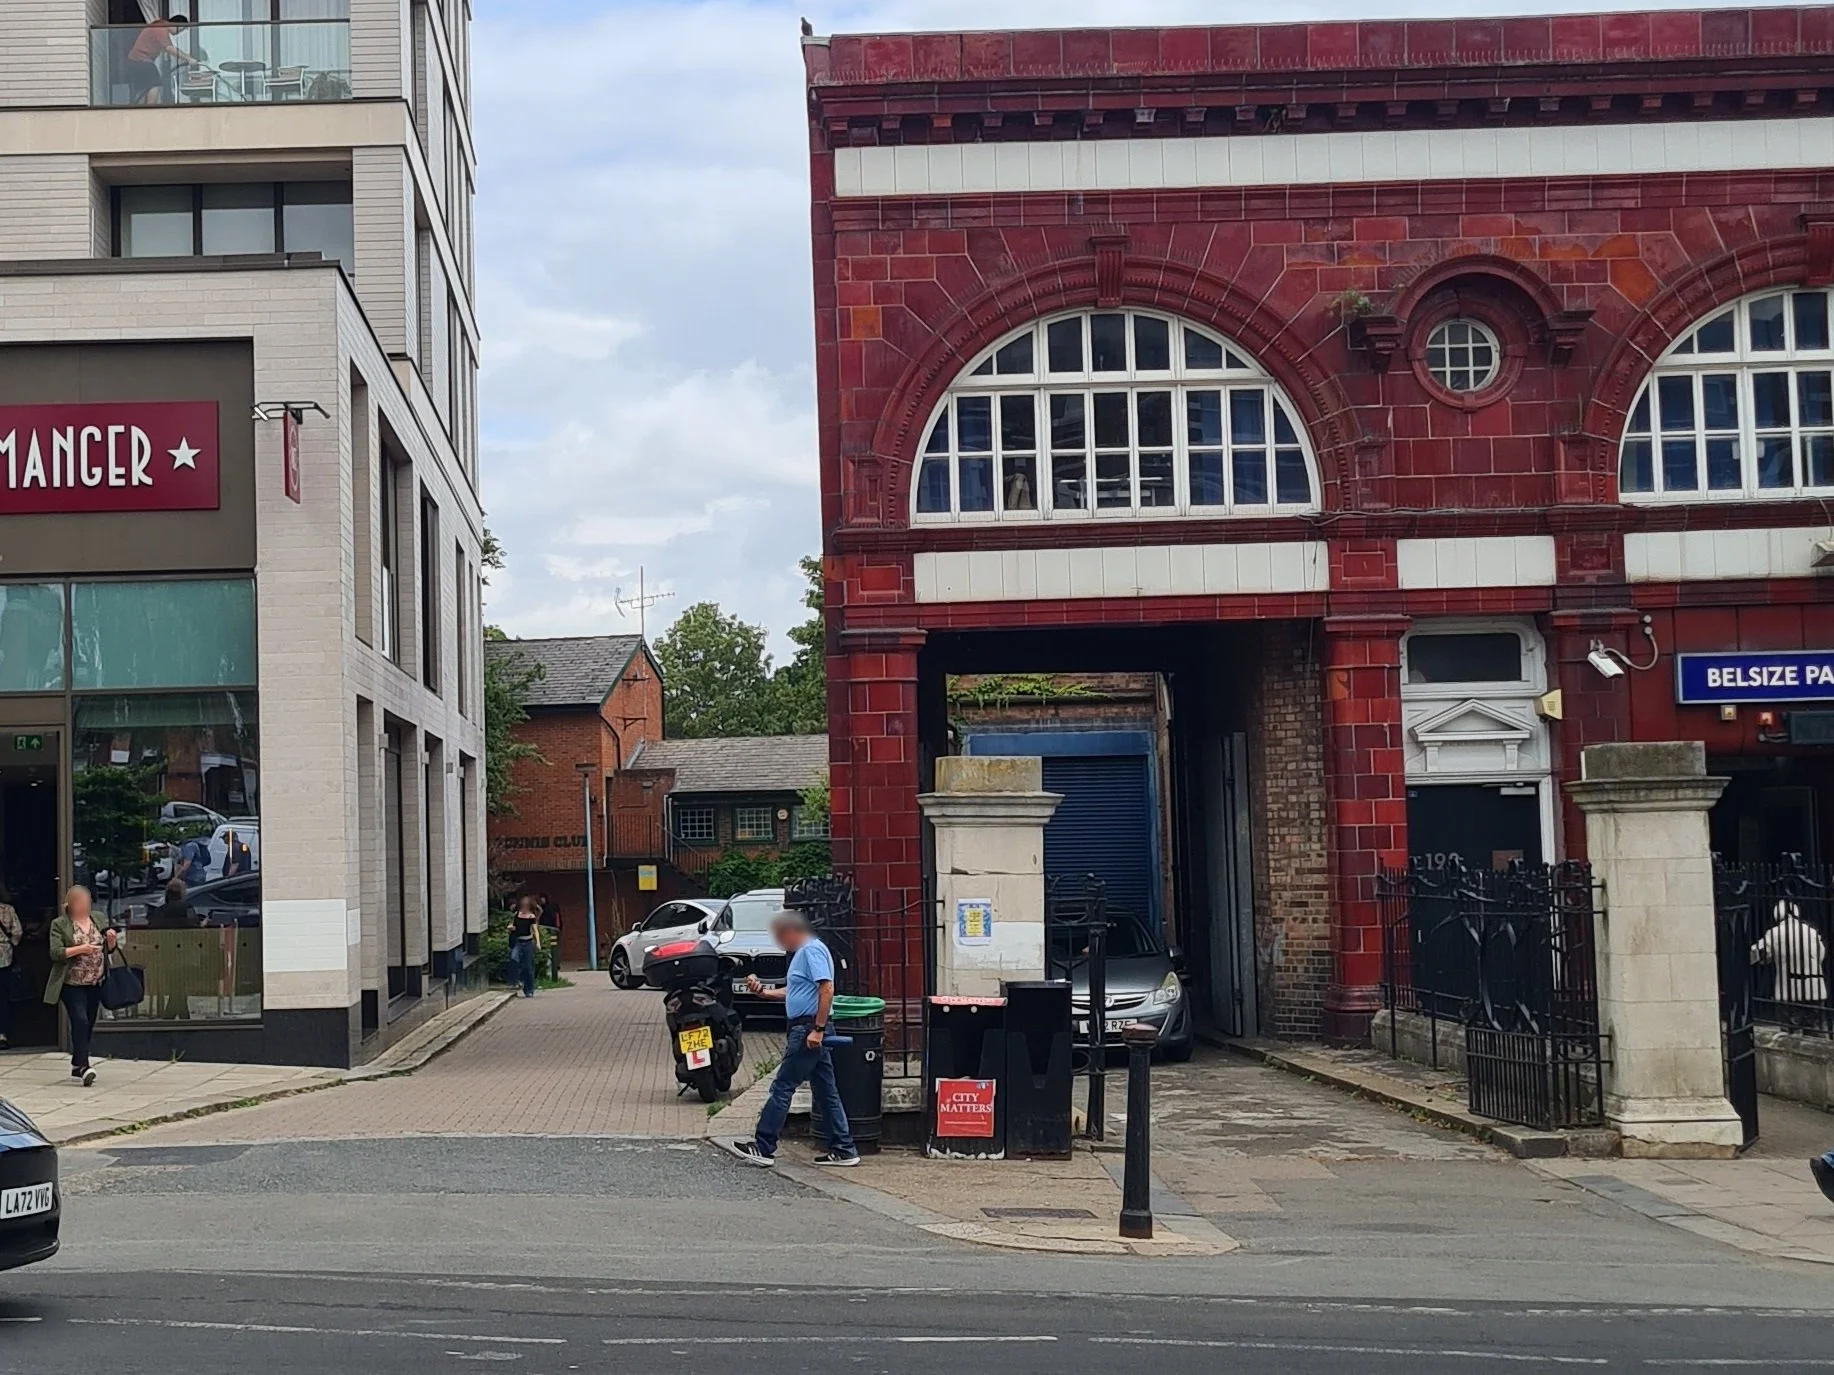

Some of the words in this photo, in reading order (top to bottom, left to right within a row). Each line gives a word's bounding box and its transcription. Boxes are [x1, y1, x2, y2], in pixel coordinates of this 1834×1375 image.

[0, 425, 153, 488] MANGER
[1707, 666, 1799, 687] BELSIZE
[687, 1038, 708, 1050] ZHE
[692, 1051, 705, 1064] L
[953, 1092, 979, 1102] CITY
[940, 1104, 992, 1113] MATTERS
[6, 1191, 33, 1214] LA72
